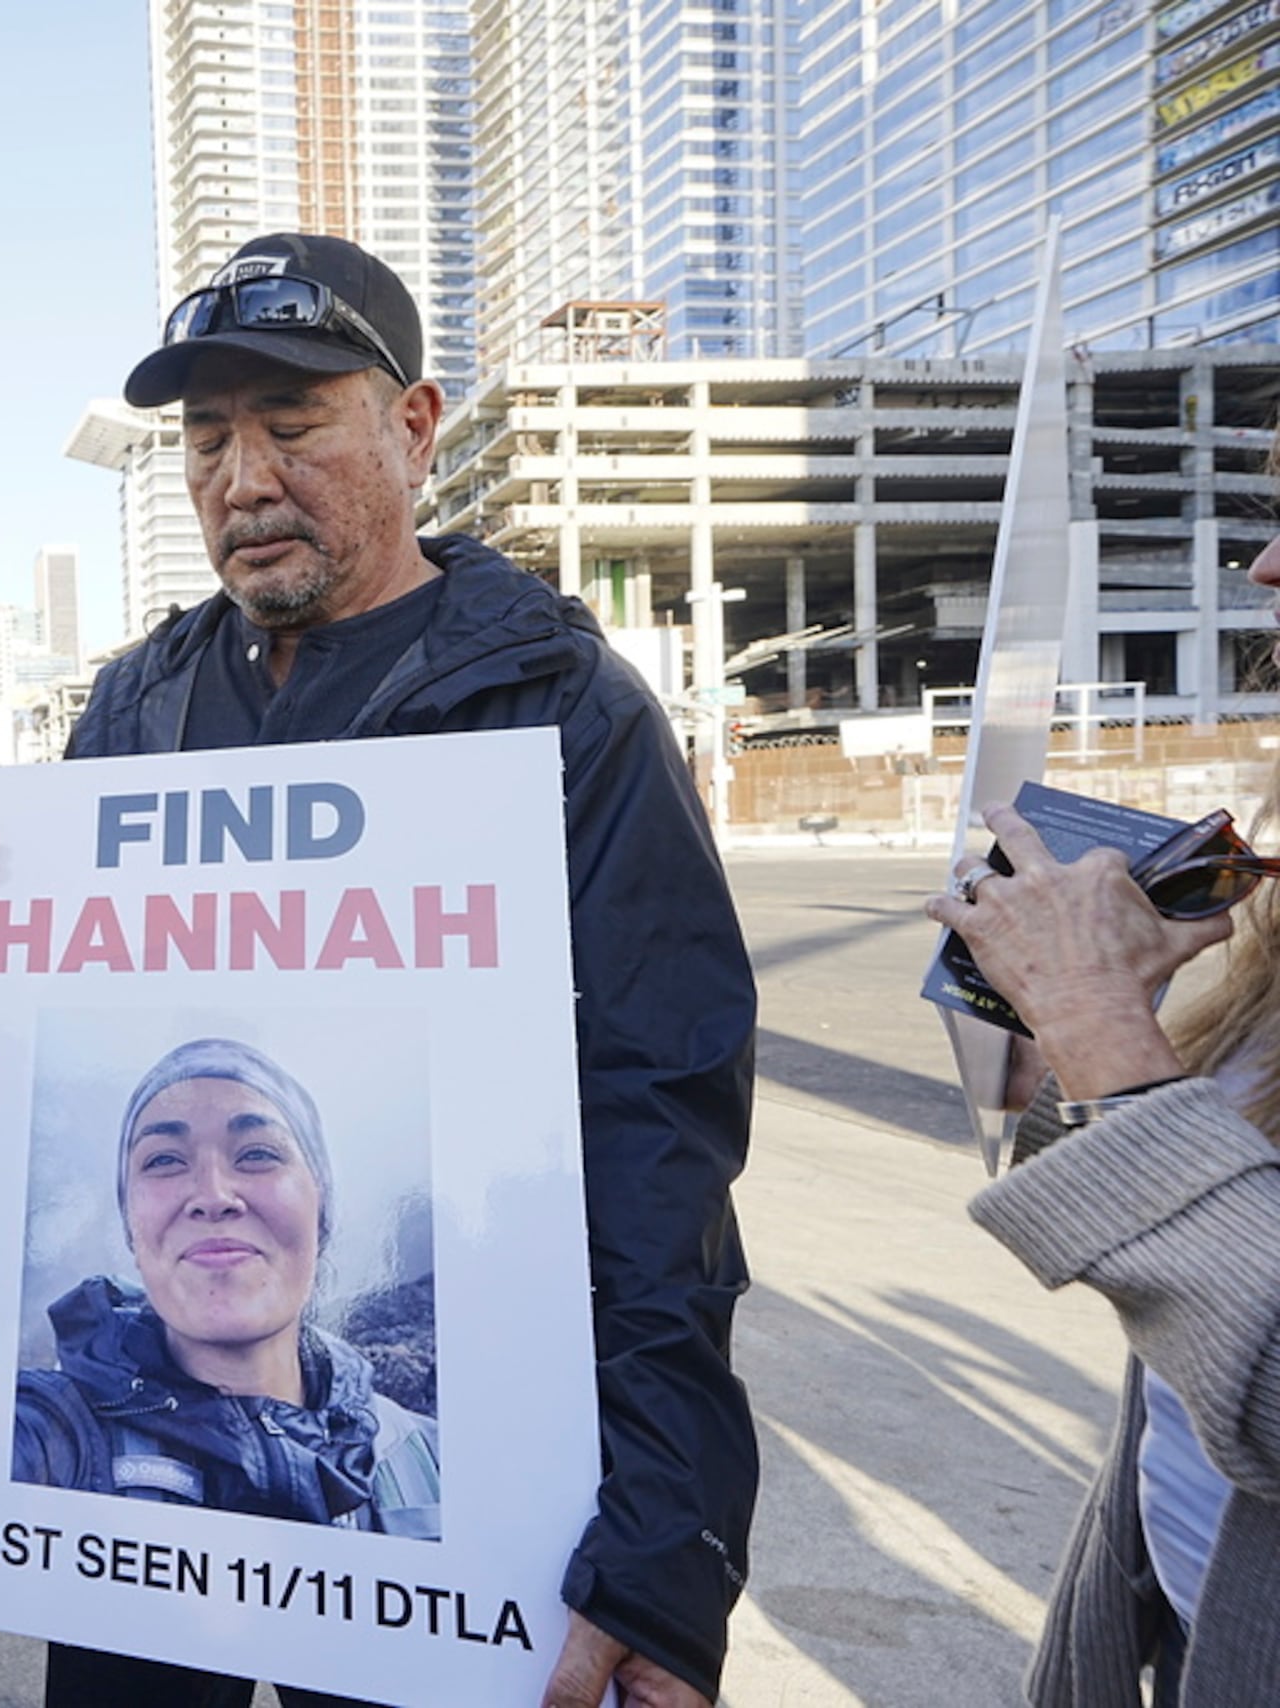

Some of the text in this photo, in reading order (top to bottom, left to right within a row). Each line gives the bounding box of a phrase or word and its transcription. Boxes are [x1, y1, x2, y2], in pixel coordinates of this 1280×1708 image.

[96, 782, 366, 868] FIND
[76, 1533, 210, 1596] SEEN
[227, 1557, 355, 1621] 11/11
[375, 1580, 534, 1651] DTLA
